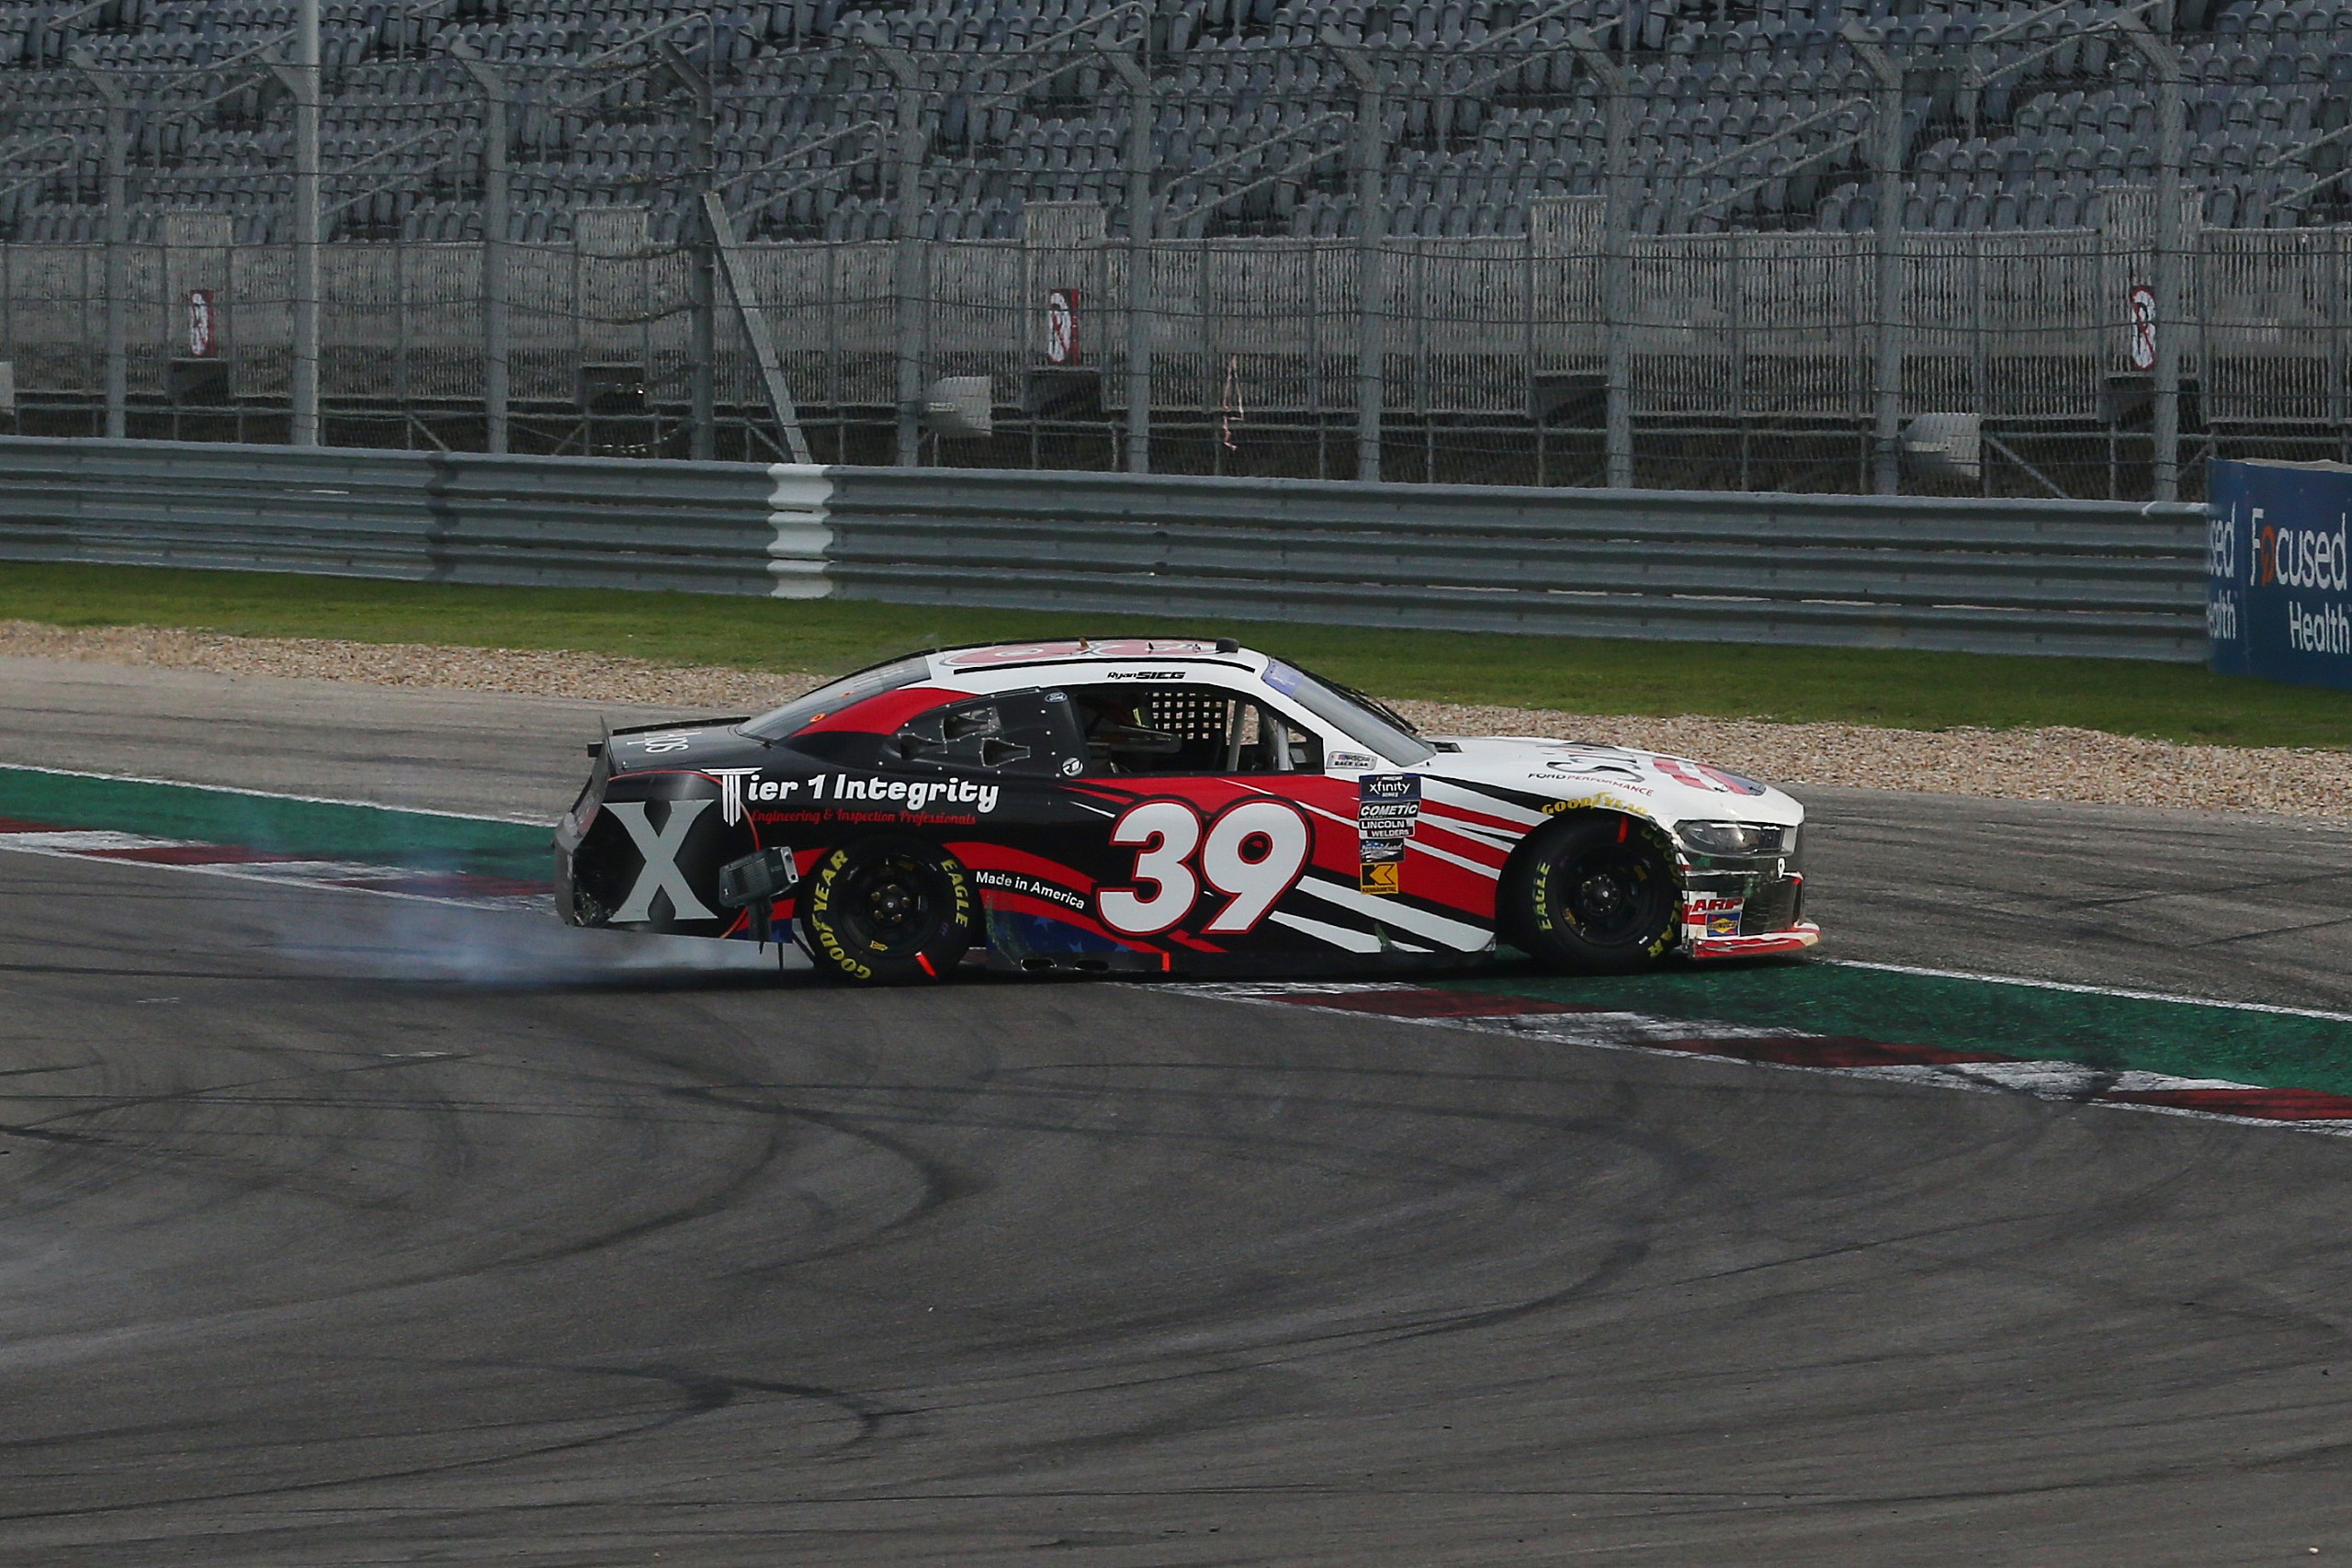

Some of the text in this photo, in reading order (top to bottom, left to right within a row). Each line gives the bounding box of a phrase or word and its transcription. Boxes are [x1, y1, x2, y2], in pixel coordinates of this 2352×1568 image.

[2250, 508, 2347, 591] Focused
[2290, 601, 2349, 654] Health
[1107, 671, 1136, 680] Ryan
[808, 773, 827, 799] 1
[833, 773, 1000, 813] Integrity
[1369, 781, 1410, 795] xfinity
[1542, 791, 1647, 815] GOODYEAR
[1566, 775, 1655, 796] PERFORMANCE
[751, 808, 978, 827] Engineering & Inspection Professionals
[1360, 803, 1419, 817] COMETIC
[1361, 820, 1405, 829] LINCOLN
[602, 798, 719, 923] X
[1098, 800, 1309, 934] 39
[941, 859, 969, 928] EAGLE
[976, 871, 1085, 909] Made in America
[1532, 860, 1554, 931] EAGLE
[1691, 898, 1744, 912] ARP
[812, 849, 872, 979] GOODYEAR
